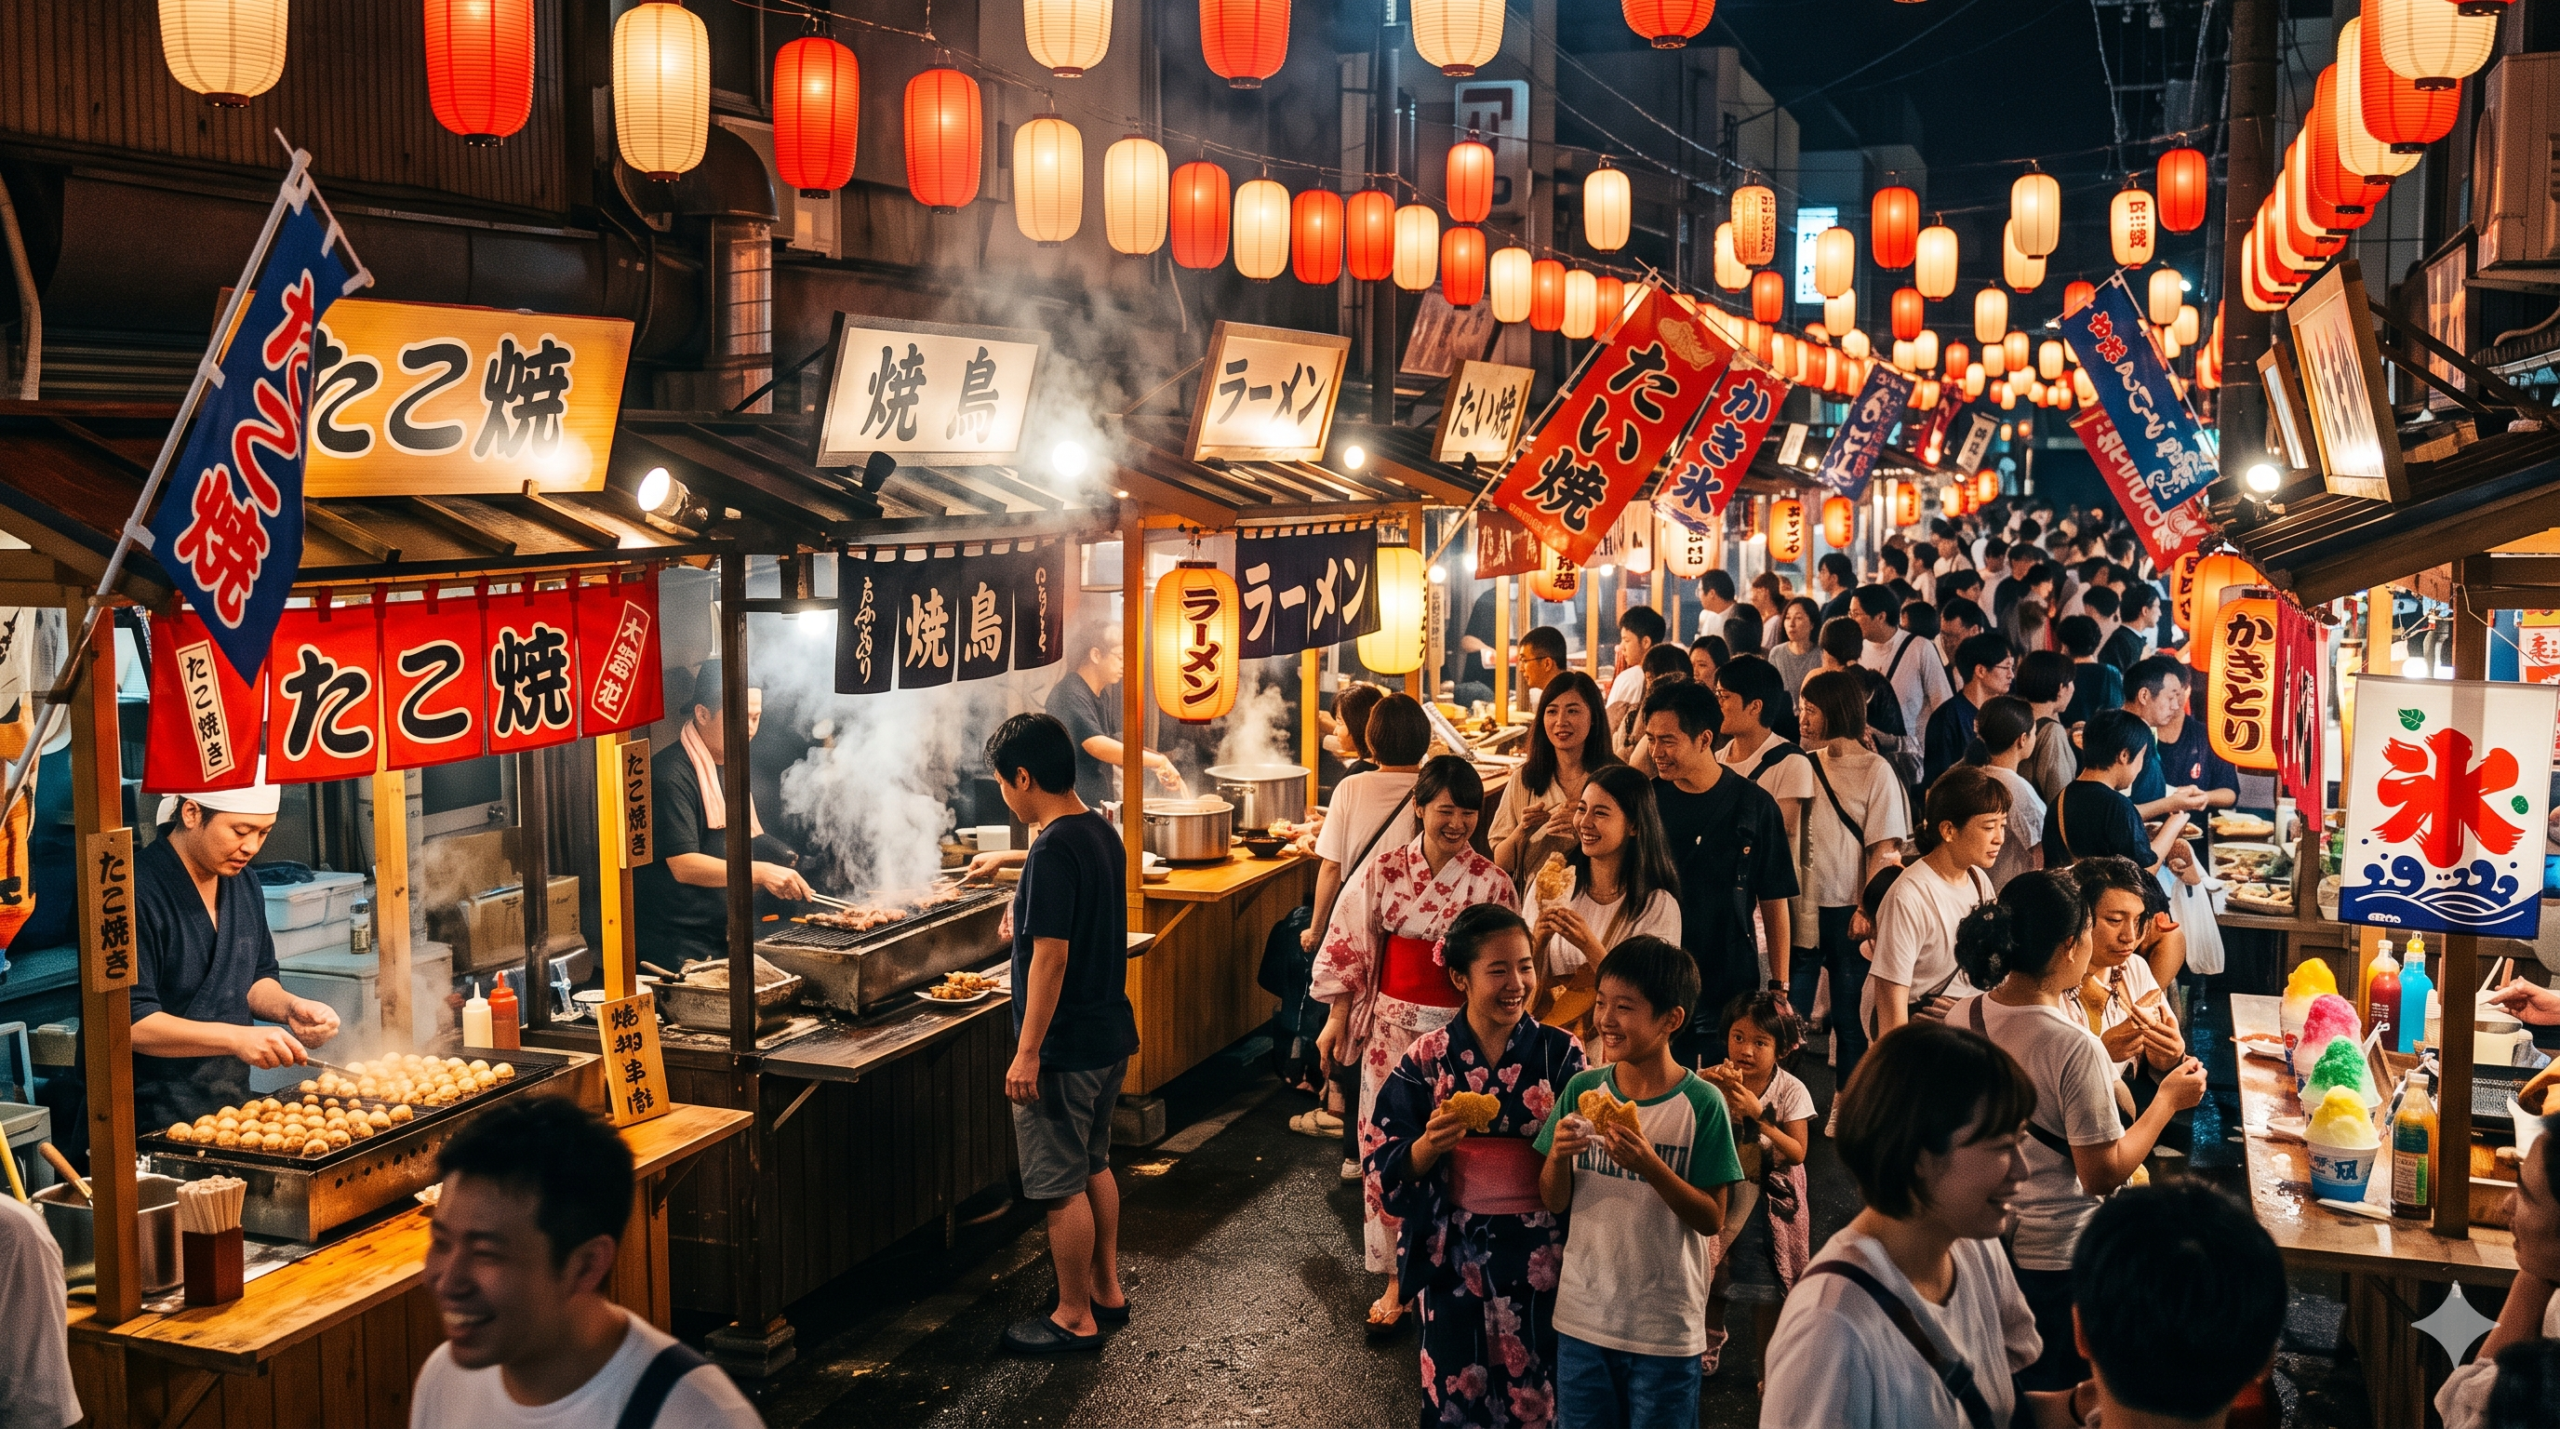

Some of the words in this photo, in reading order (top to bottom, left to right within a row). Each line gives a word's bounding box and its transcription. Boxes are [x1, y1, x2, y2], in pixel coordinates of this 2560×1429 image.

[312, 319, 575, 460] たこ焼
[860, 342, 999, 444] 焼鳥
[1217, 358, 1327, 426] ラーメン
[1451, 382, 1517, 440] たい焼
[1525, 343, 1679, 533] たい焼
[1673, 379, 1771, 514] かき氷
[905, 581, 1003, 669] 焼鳥
[1182, 588, 1221, 705] ラーメン
[1243, 557, 1368, 642] ラーメン
[186, 656, 223, 768] たこ焼き
[282, 623, 572, 760] たこ焼
[2223, 613, 2274, 751] かきとり
[627, 753, 648, 857] たこ焼き
[2370, 727, 2526, 869] 氷
[99, 851, 130, 980] たこ焼き
